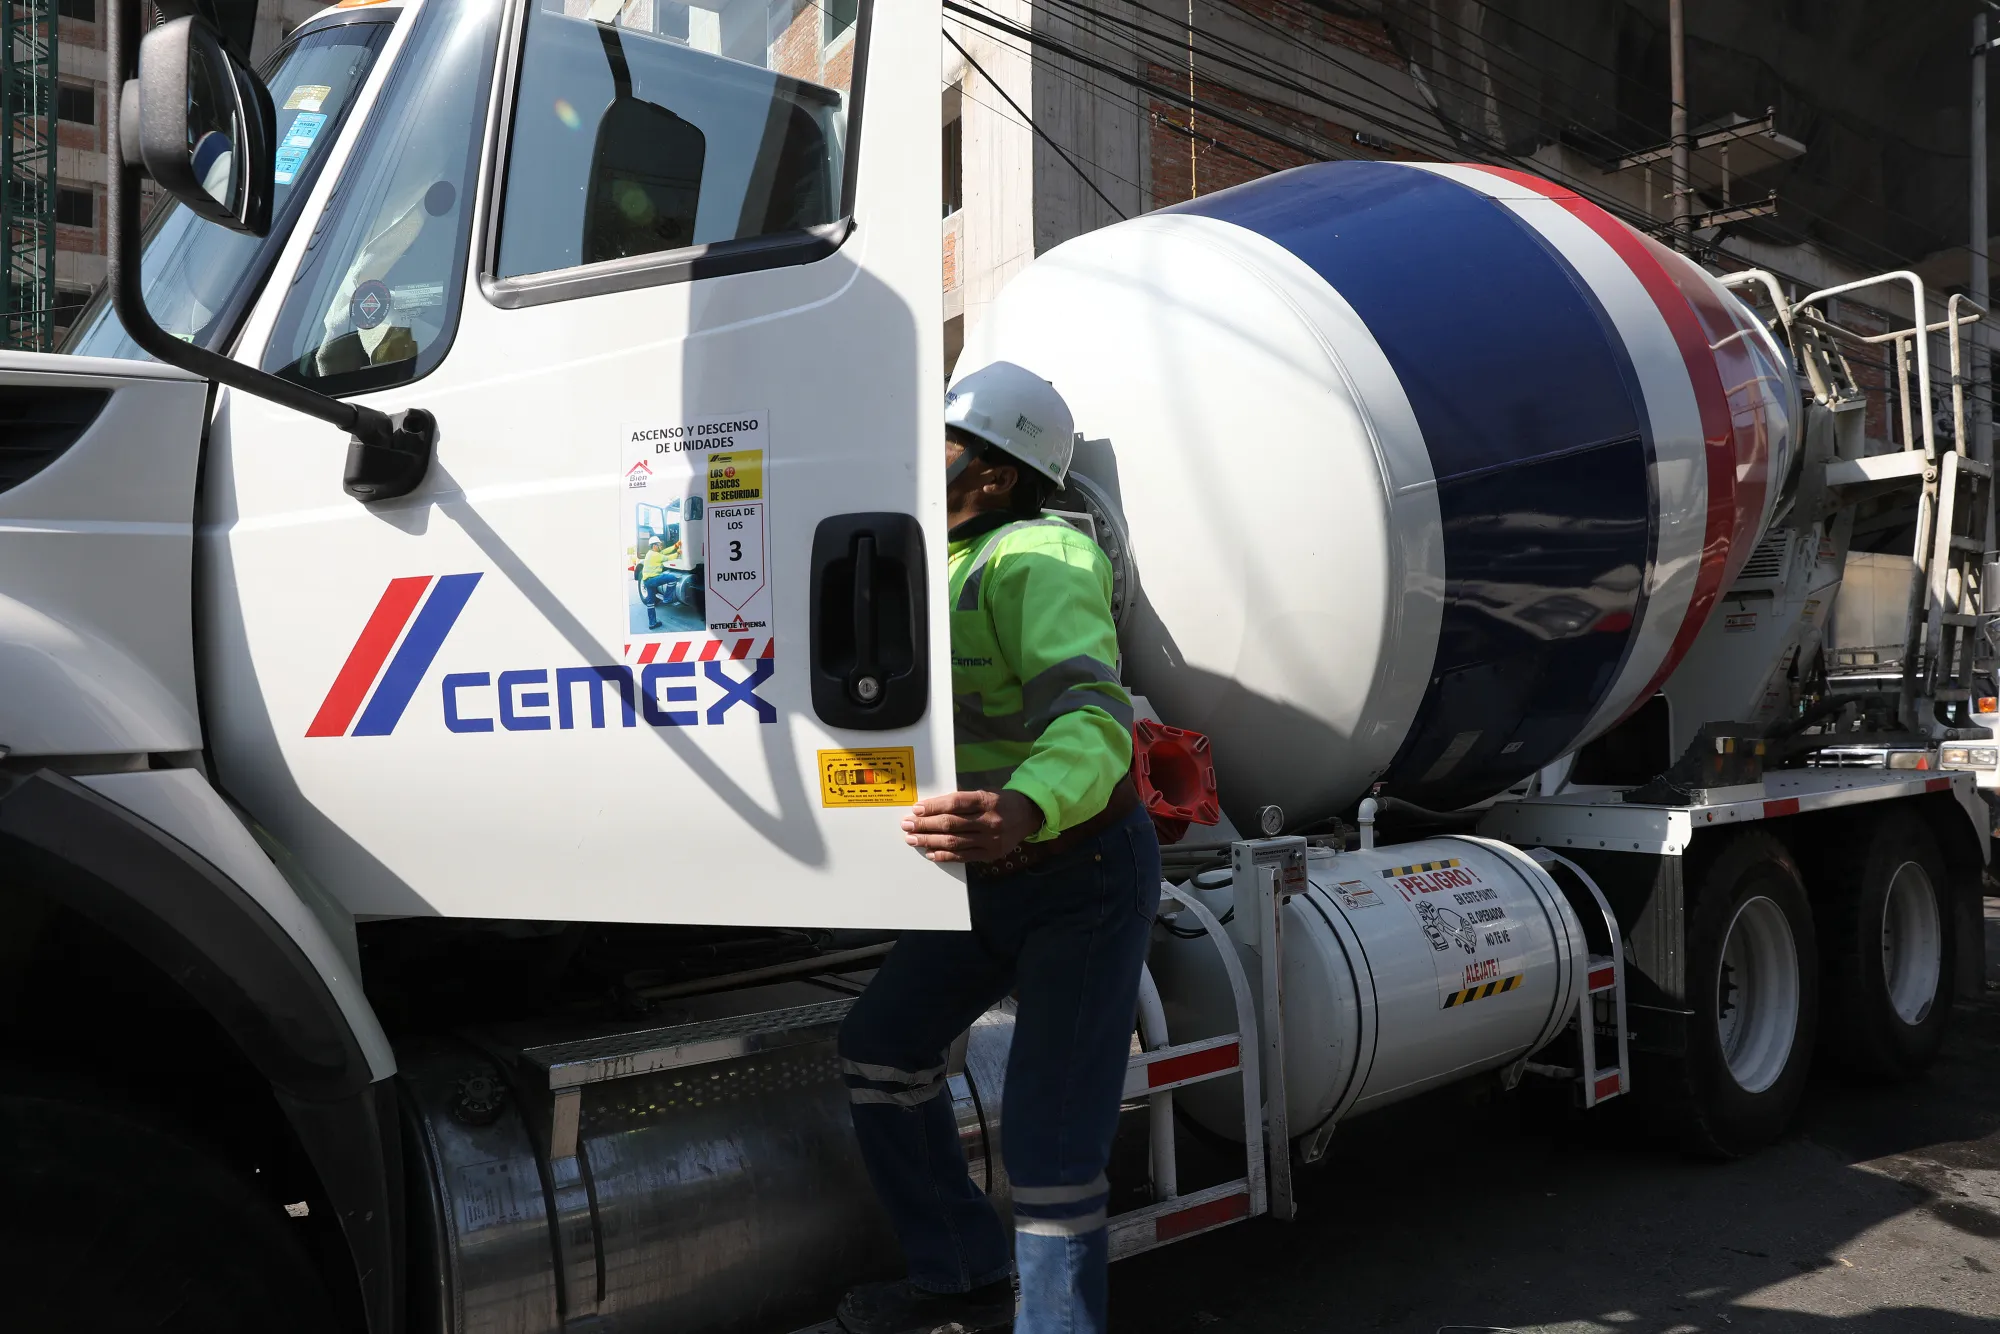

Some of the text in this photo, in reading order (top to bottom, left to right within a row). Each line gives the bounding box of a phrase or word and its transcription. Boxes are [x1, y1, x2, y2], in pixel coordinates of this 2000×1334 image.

[632, 419, 759, 442] ASCENSO Y DESCENSO
[655, 436, 734, 454] DE UNIDADES
[710, 469, 724, 479] LOS
[710, 478, 740, 490] BÁSICOS
[710, 488, 760, 501] DE SEGURIDAD
[715, 507, 755, 518] REGLA DE
[727, 521, 743, 530] LOS
[729, 540, 743, 562] 3
[717, 571, 757, 582] PUNTOS
[710, 620, 767, 630] DETENTE Y PIENSA
[442, 658, 777, 733] CEMEX
[1452, 888, 1498, 906] EN ESTE PUNTO
[1467, 906, 1507, 925] EL OPERADOR
[1484, 932, 1495, 947] NO
[1493, 930, 1503, 945] TE
